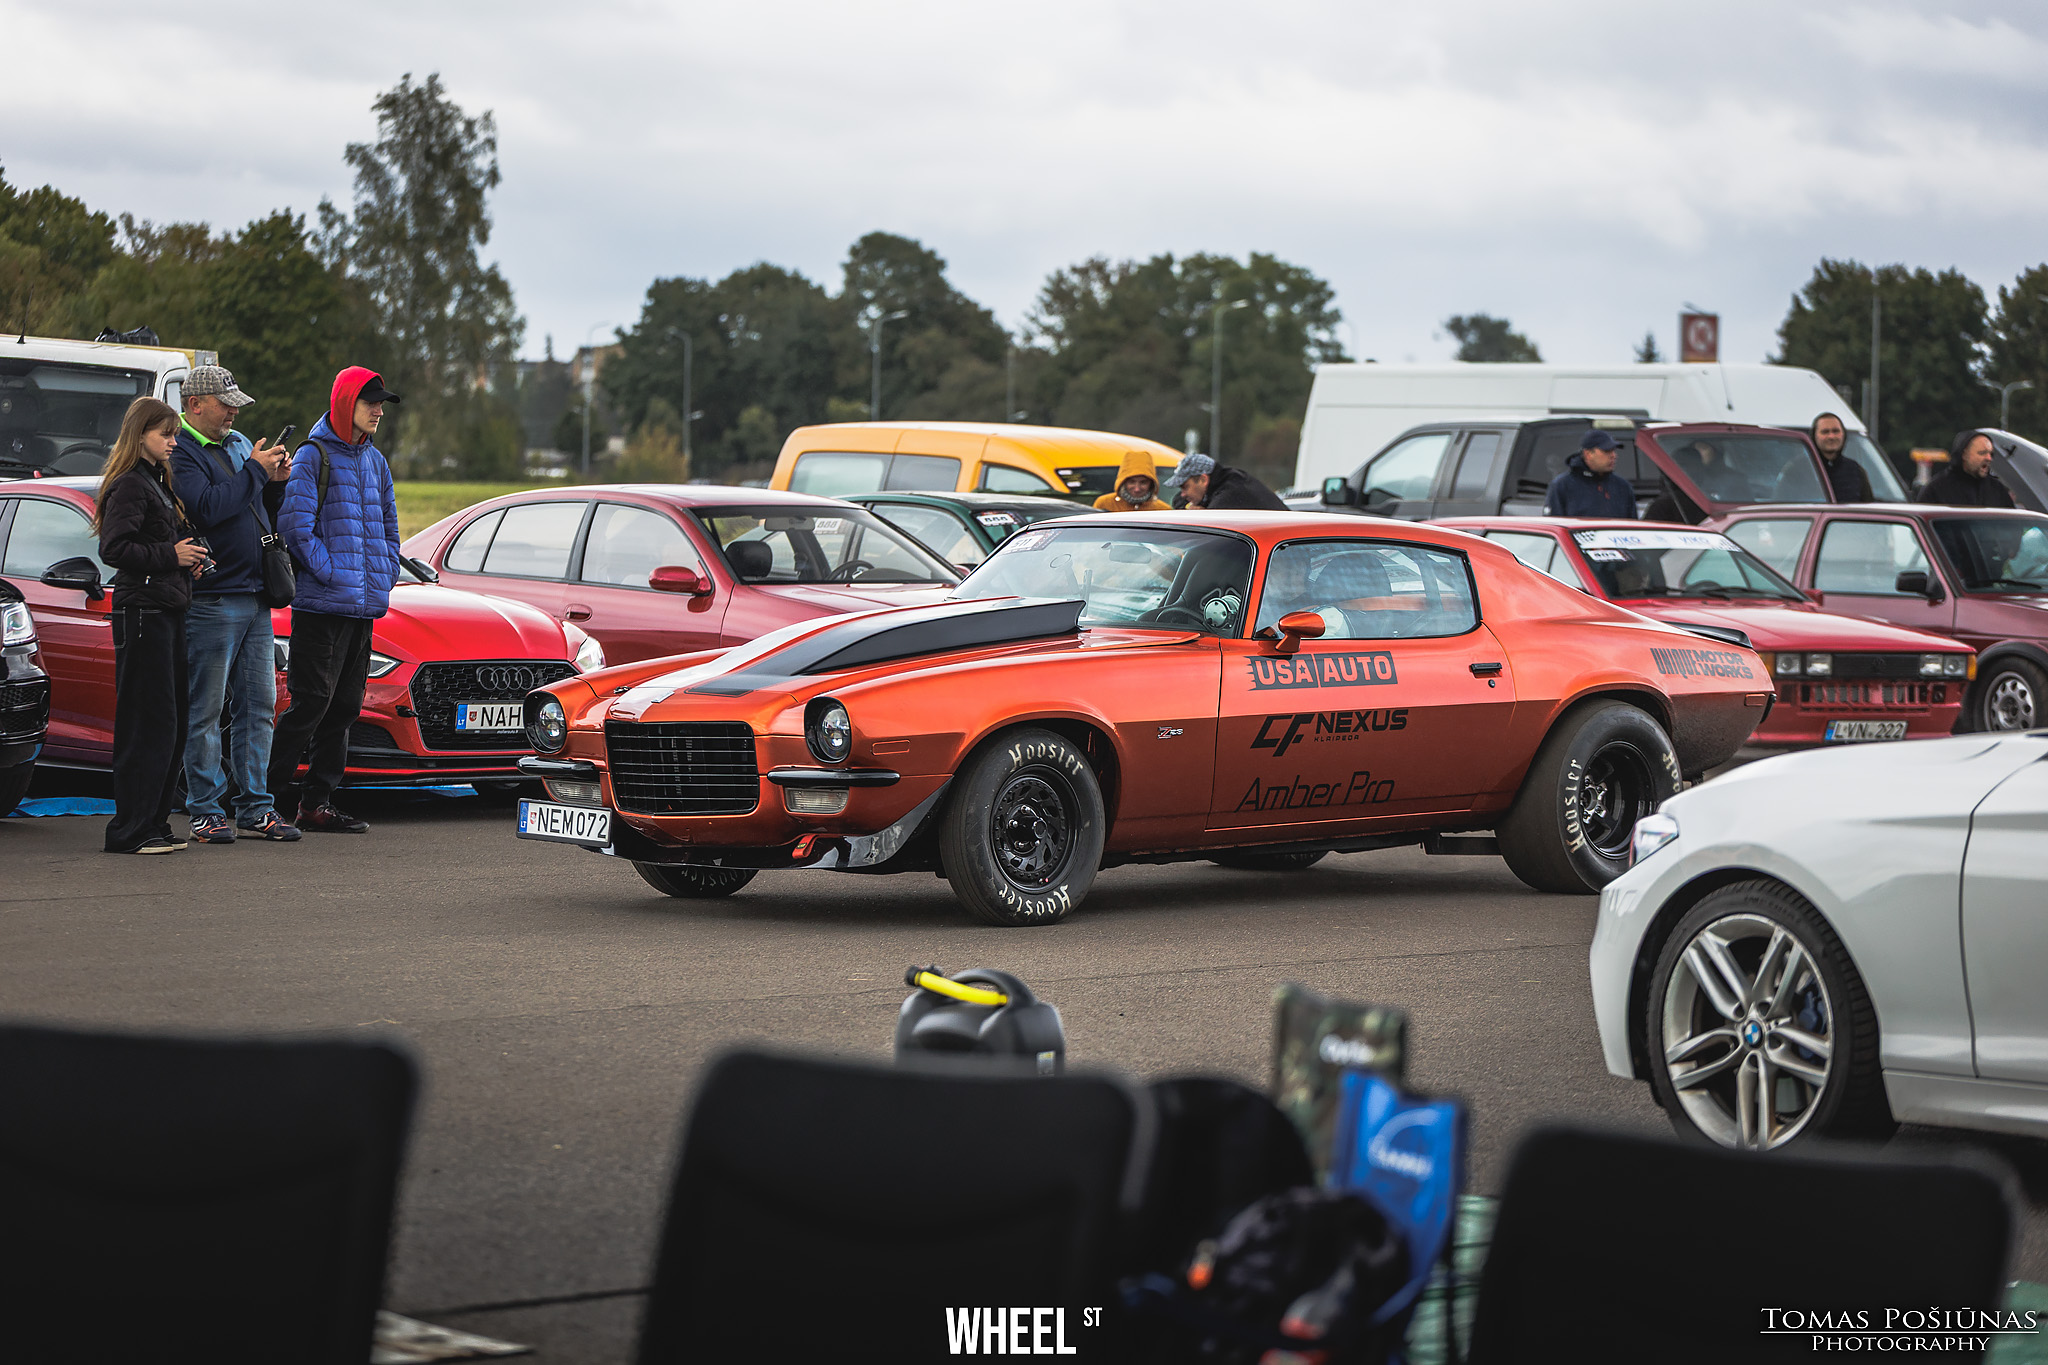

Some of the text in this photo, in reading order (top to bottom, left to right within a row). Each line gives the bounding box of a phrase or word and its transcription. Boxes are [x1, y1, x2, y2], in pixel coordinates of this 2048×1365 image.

[1254, 655, 1392, 685] USA AUTO
[1650, 647, 1745, 679] UNIQUE MOTOR
[1700, 664, 1754, 680] WORKS
[480, 706, 522, 727] NAH
[1315, 709, 1409, 734] NEXUS
[1313, 734, 1360, 742] KLAIPEDA
[1008, 743, 1084, 776] Hoosier
[1234, 771, 1396, 813] Amber Pro
[1564, 759, 1586, 854] Hoosier
[537, 807, 608, 839] NEM072
[999, 883, 1072, 916] Hoosier
